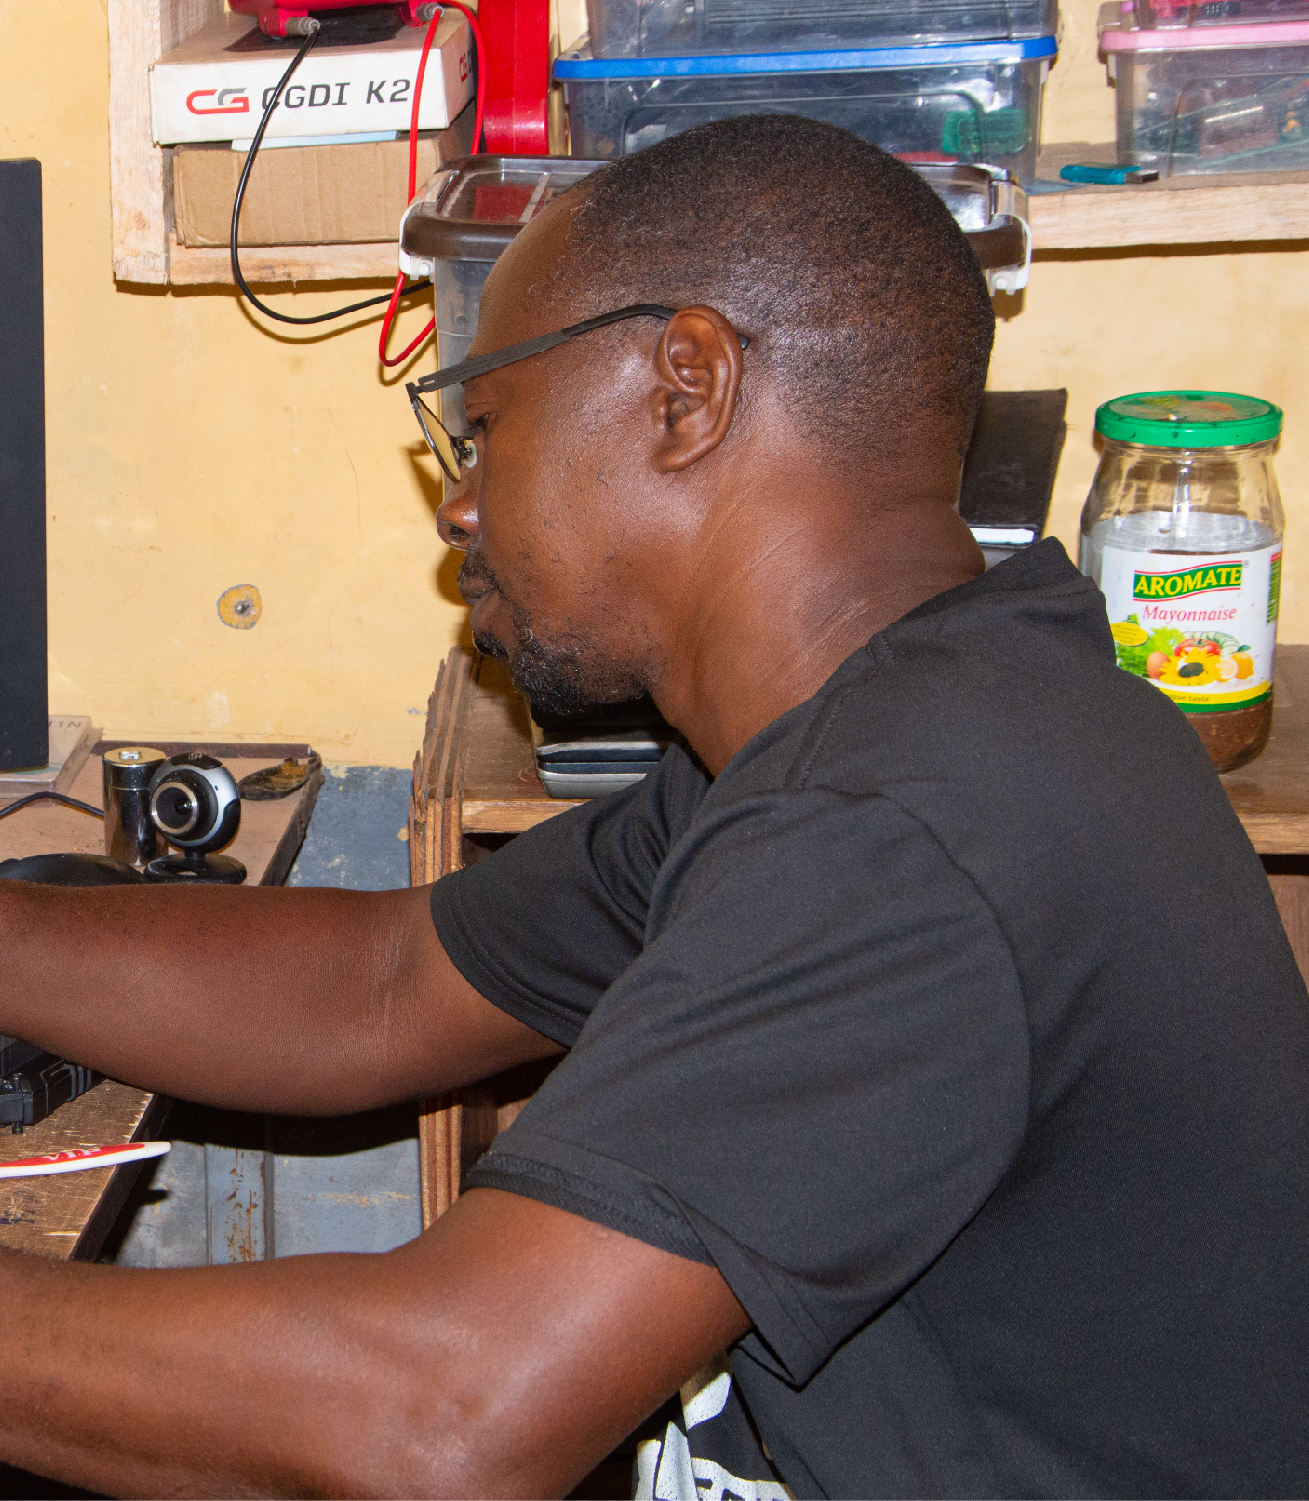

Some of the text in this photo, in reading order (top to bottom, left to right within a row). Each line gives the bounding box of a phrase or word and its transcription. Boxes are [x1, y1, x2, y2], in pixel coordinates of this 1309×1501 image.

[261, 82, 351, 110] CGDI
[366, 79, 411, 104] K2
[1134, 567, 1242, 596] AROMATE
[1142, 605, 1238, 625] Mayonnaise
[1187, 695, 1211, 703] taste
